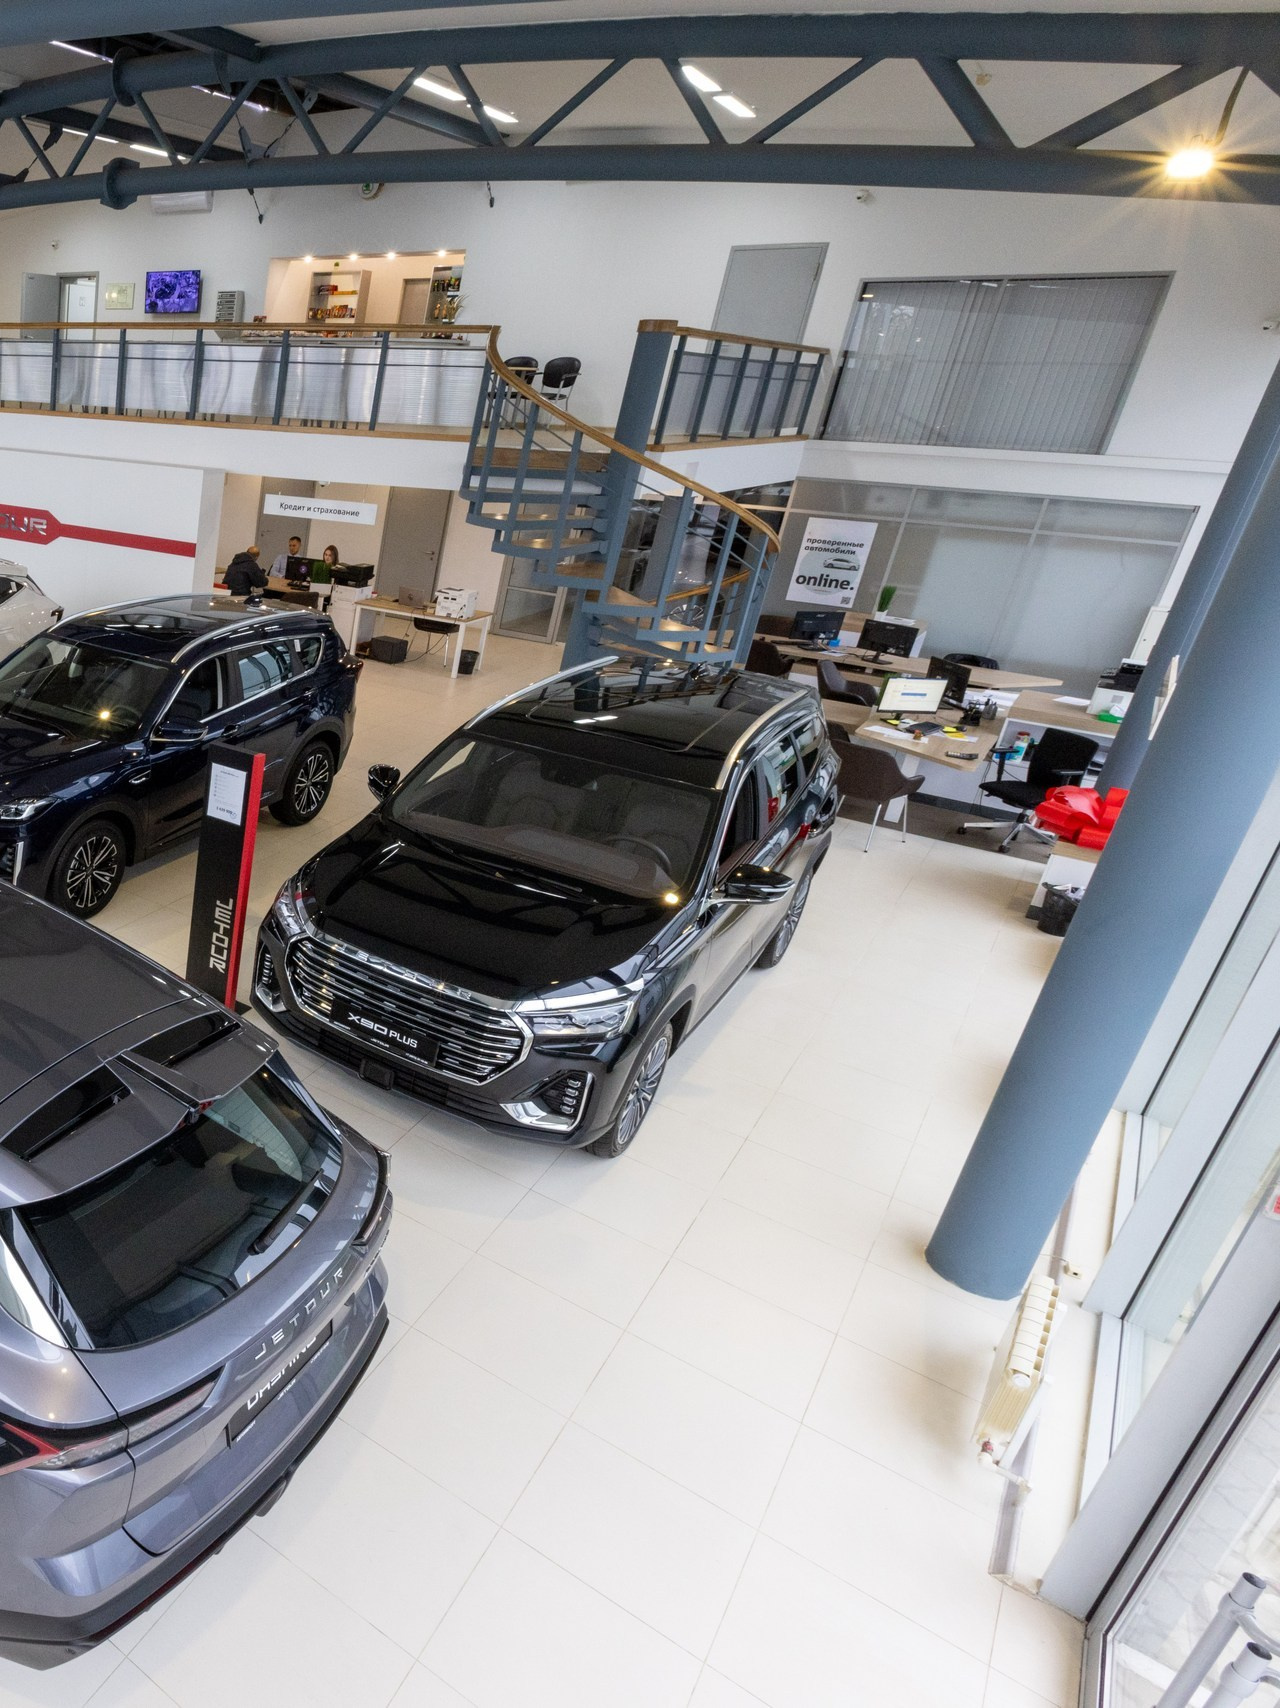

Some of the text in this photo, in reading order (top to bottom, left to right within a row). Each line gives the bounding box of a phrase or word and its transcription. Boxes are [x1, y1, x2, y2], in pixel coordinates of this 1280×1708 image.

[279, 502, 306, 512] Кредит
[312, 506, 360, 518] страхование
[804, 545, 857, 556] автомобили
[806, 537, 865, 549] проверенные
[795, 573, 855, 591] online.
[209, 898, 234, 974] JETOUR
[347, 1011, 418, 1049] X90 PLUS
[254, 1266, 344, 1361] JETOUR
